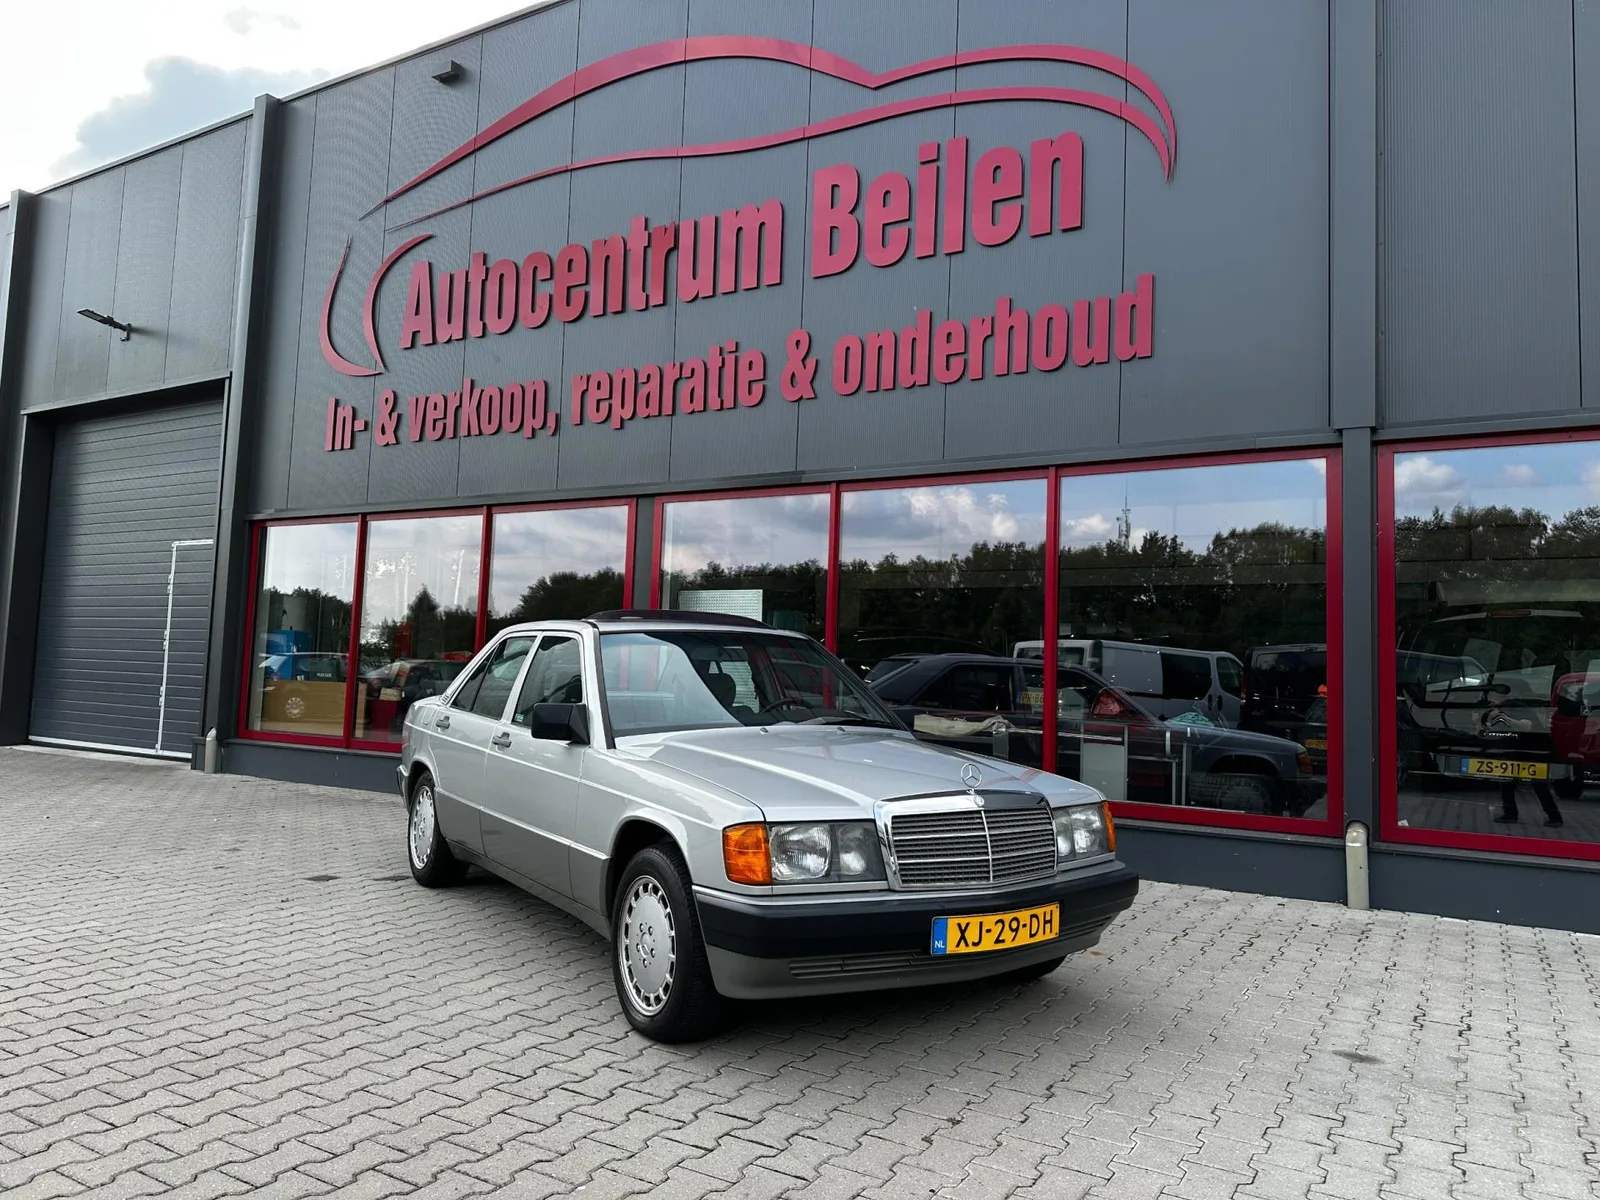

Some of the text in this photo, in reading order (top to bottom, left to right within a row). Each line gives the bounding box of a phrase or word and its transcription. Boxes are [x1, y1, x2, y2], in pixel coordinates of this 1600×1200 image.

[400, 131, 1084, 349] Autocentrum Beilen
[324, 273, 1155, 451] In- & verkoop, reparatie & onderhoud
[1475, 760, 1537, 776] ZS-911-G
[934, 909, 1053, 949] NL XJ-29-DH
